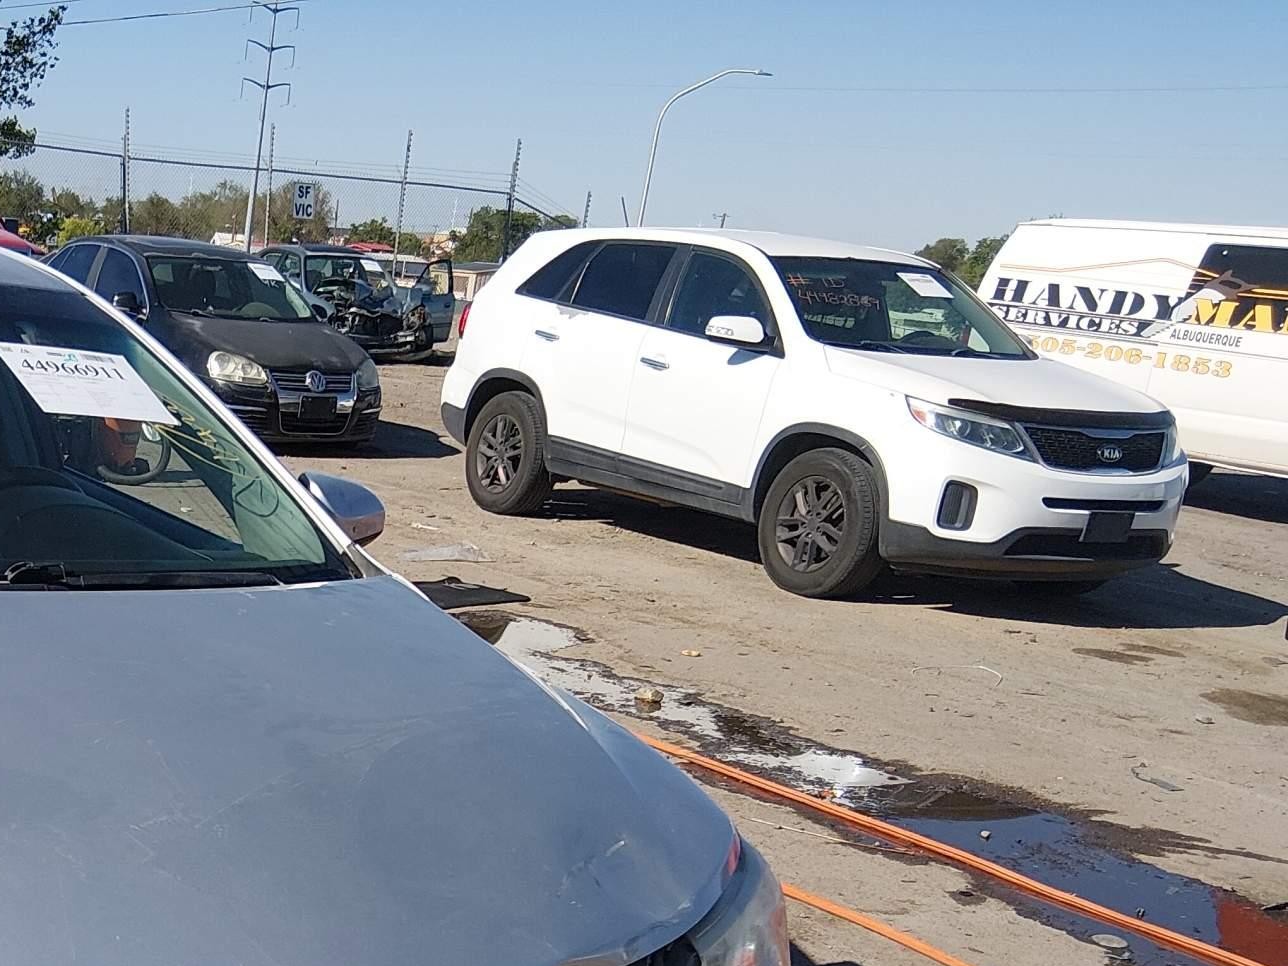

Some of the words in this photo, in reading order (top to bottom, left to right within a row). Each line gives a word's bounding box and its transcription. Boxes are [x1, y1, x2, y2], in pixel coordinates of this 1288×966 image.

[298, 185, 311, 199] SF
[295, 203, 312, 217] VIC
[990, 277, 1184, 321] HANDY
[1185, 298, 1288, 336] MA
[992, 305, 1139, 334] SERVICES
[1170, 328, 1243, 348] ALBUQUERQUE
[21, 359, 126, 381] 44966911
[1103, 448, 1120, 459] KIA
